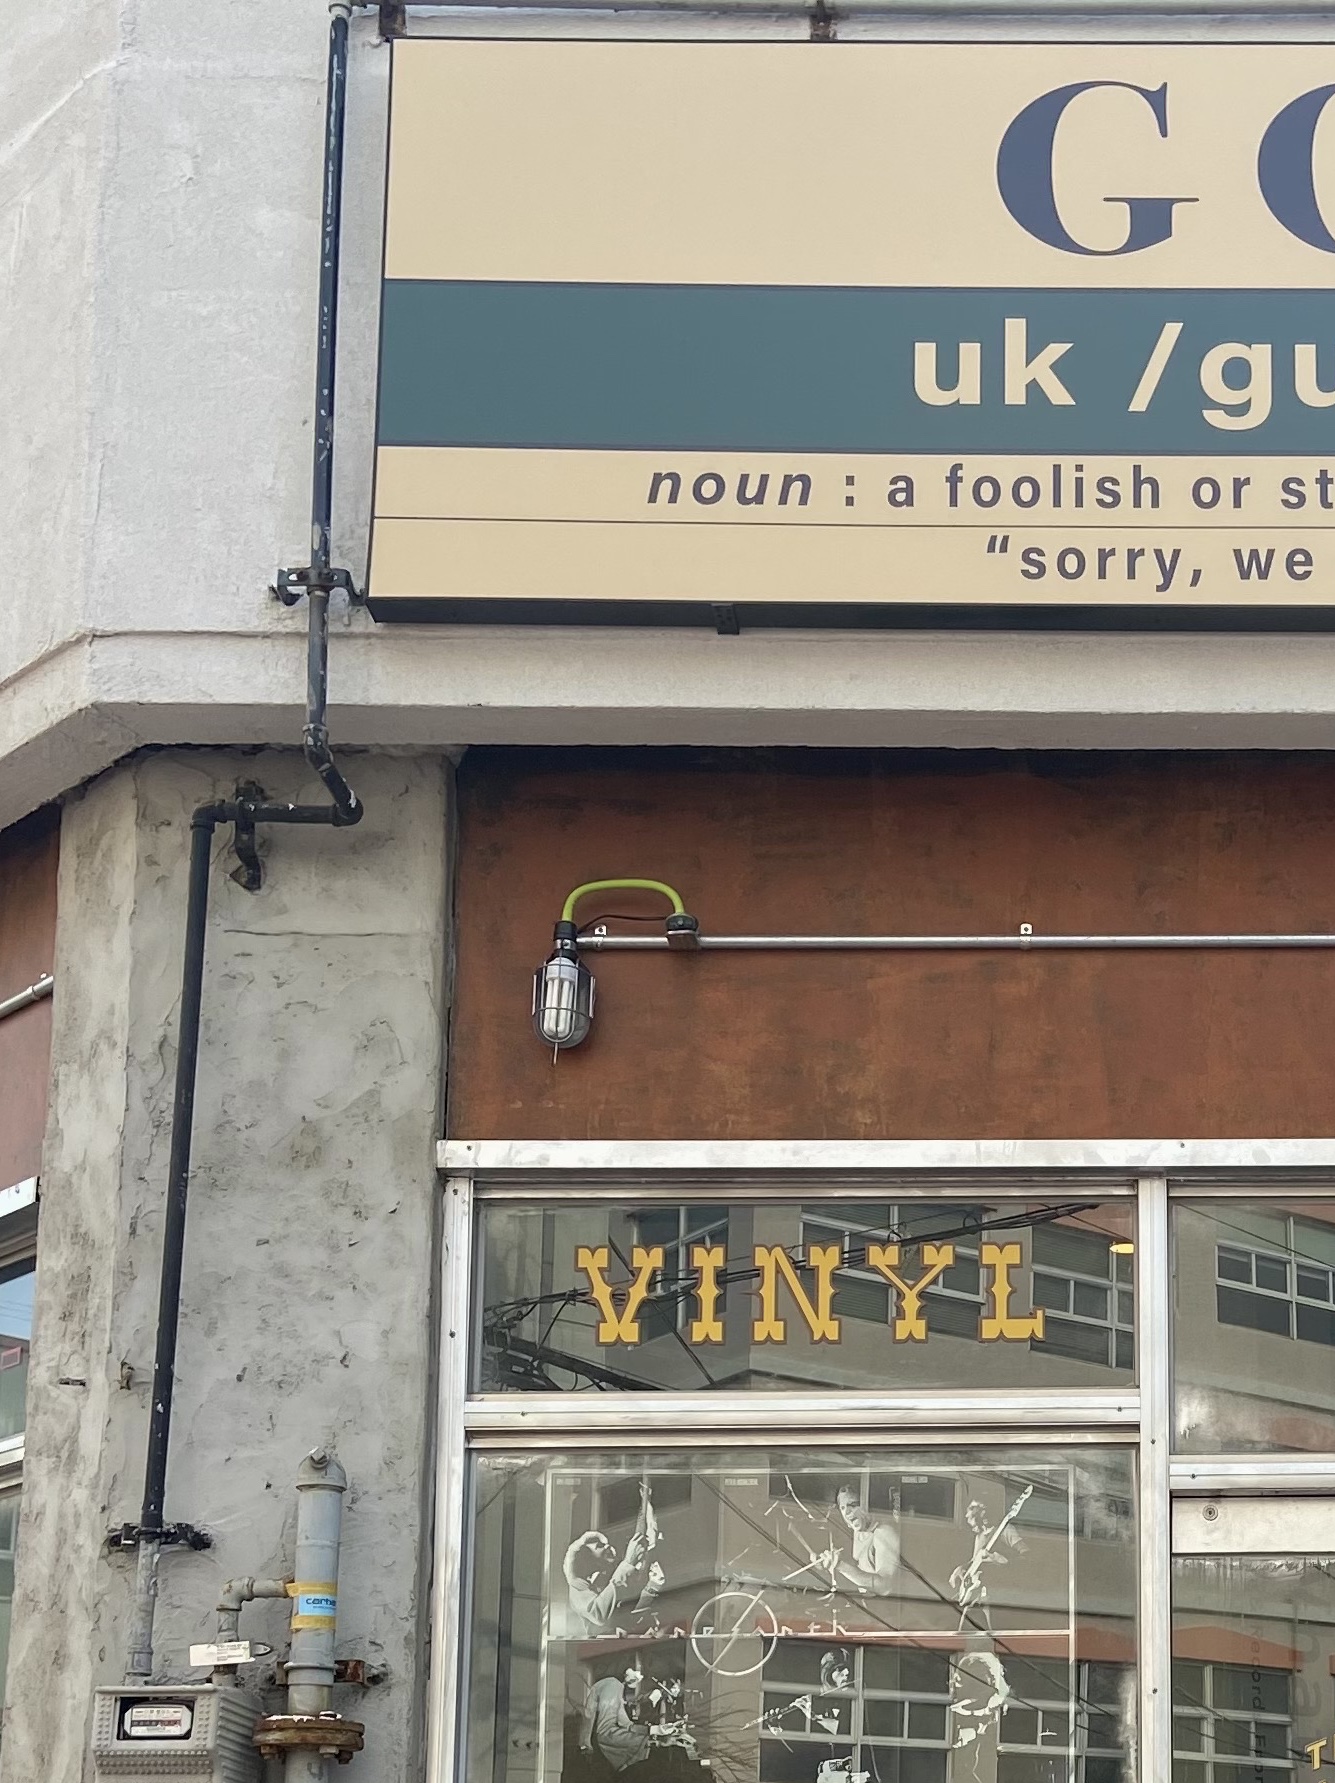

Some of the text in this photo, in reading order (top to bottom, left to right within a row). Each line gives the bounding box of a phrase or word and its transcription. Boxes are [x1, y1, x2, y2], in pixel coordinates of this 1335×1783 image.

[912, 318, 1076, 407] uk
[646, 469, 814, 508] noun
[886, 474, 918, 510] a
[946, 465, 1162, 510] foolish
[1191, 475, 1252, 510] or
[1232, 548, 1316, 581] we
[574, 1242, 1046, 1345] VINYL
